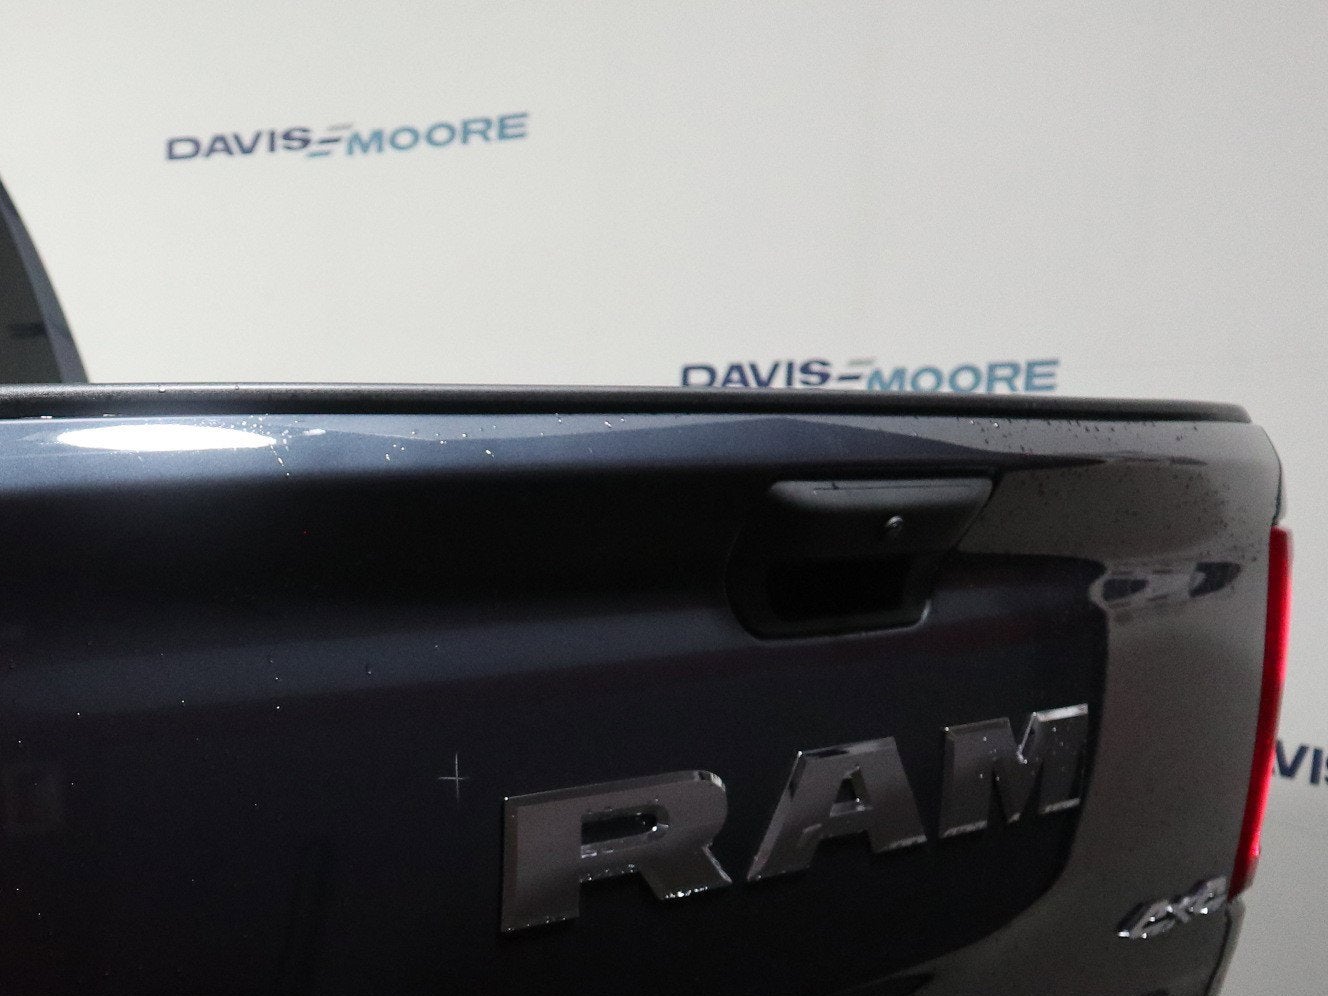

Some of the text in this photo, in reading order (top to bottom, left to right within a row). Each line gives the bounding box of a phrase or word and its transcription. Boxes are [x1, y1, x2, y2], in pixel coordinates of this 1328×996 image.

[165, 111, 528, 160] DAVIS MOORE
[500, 703, 1089, 934] RAM
